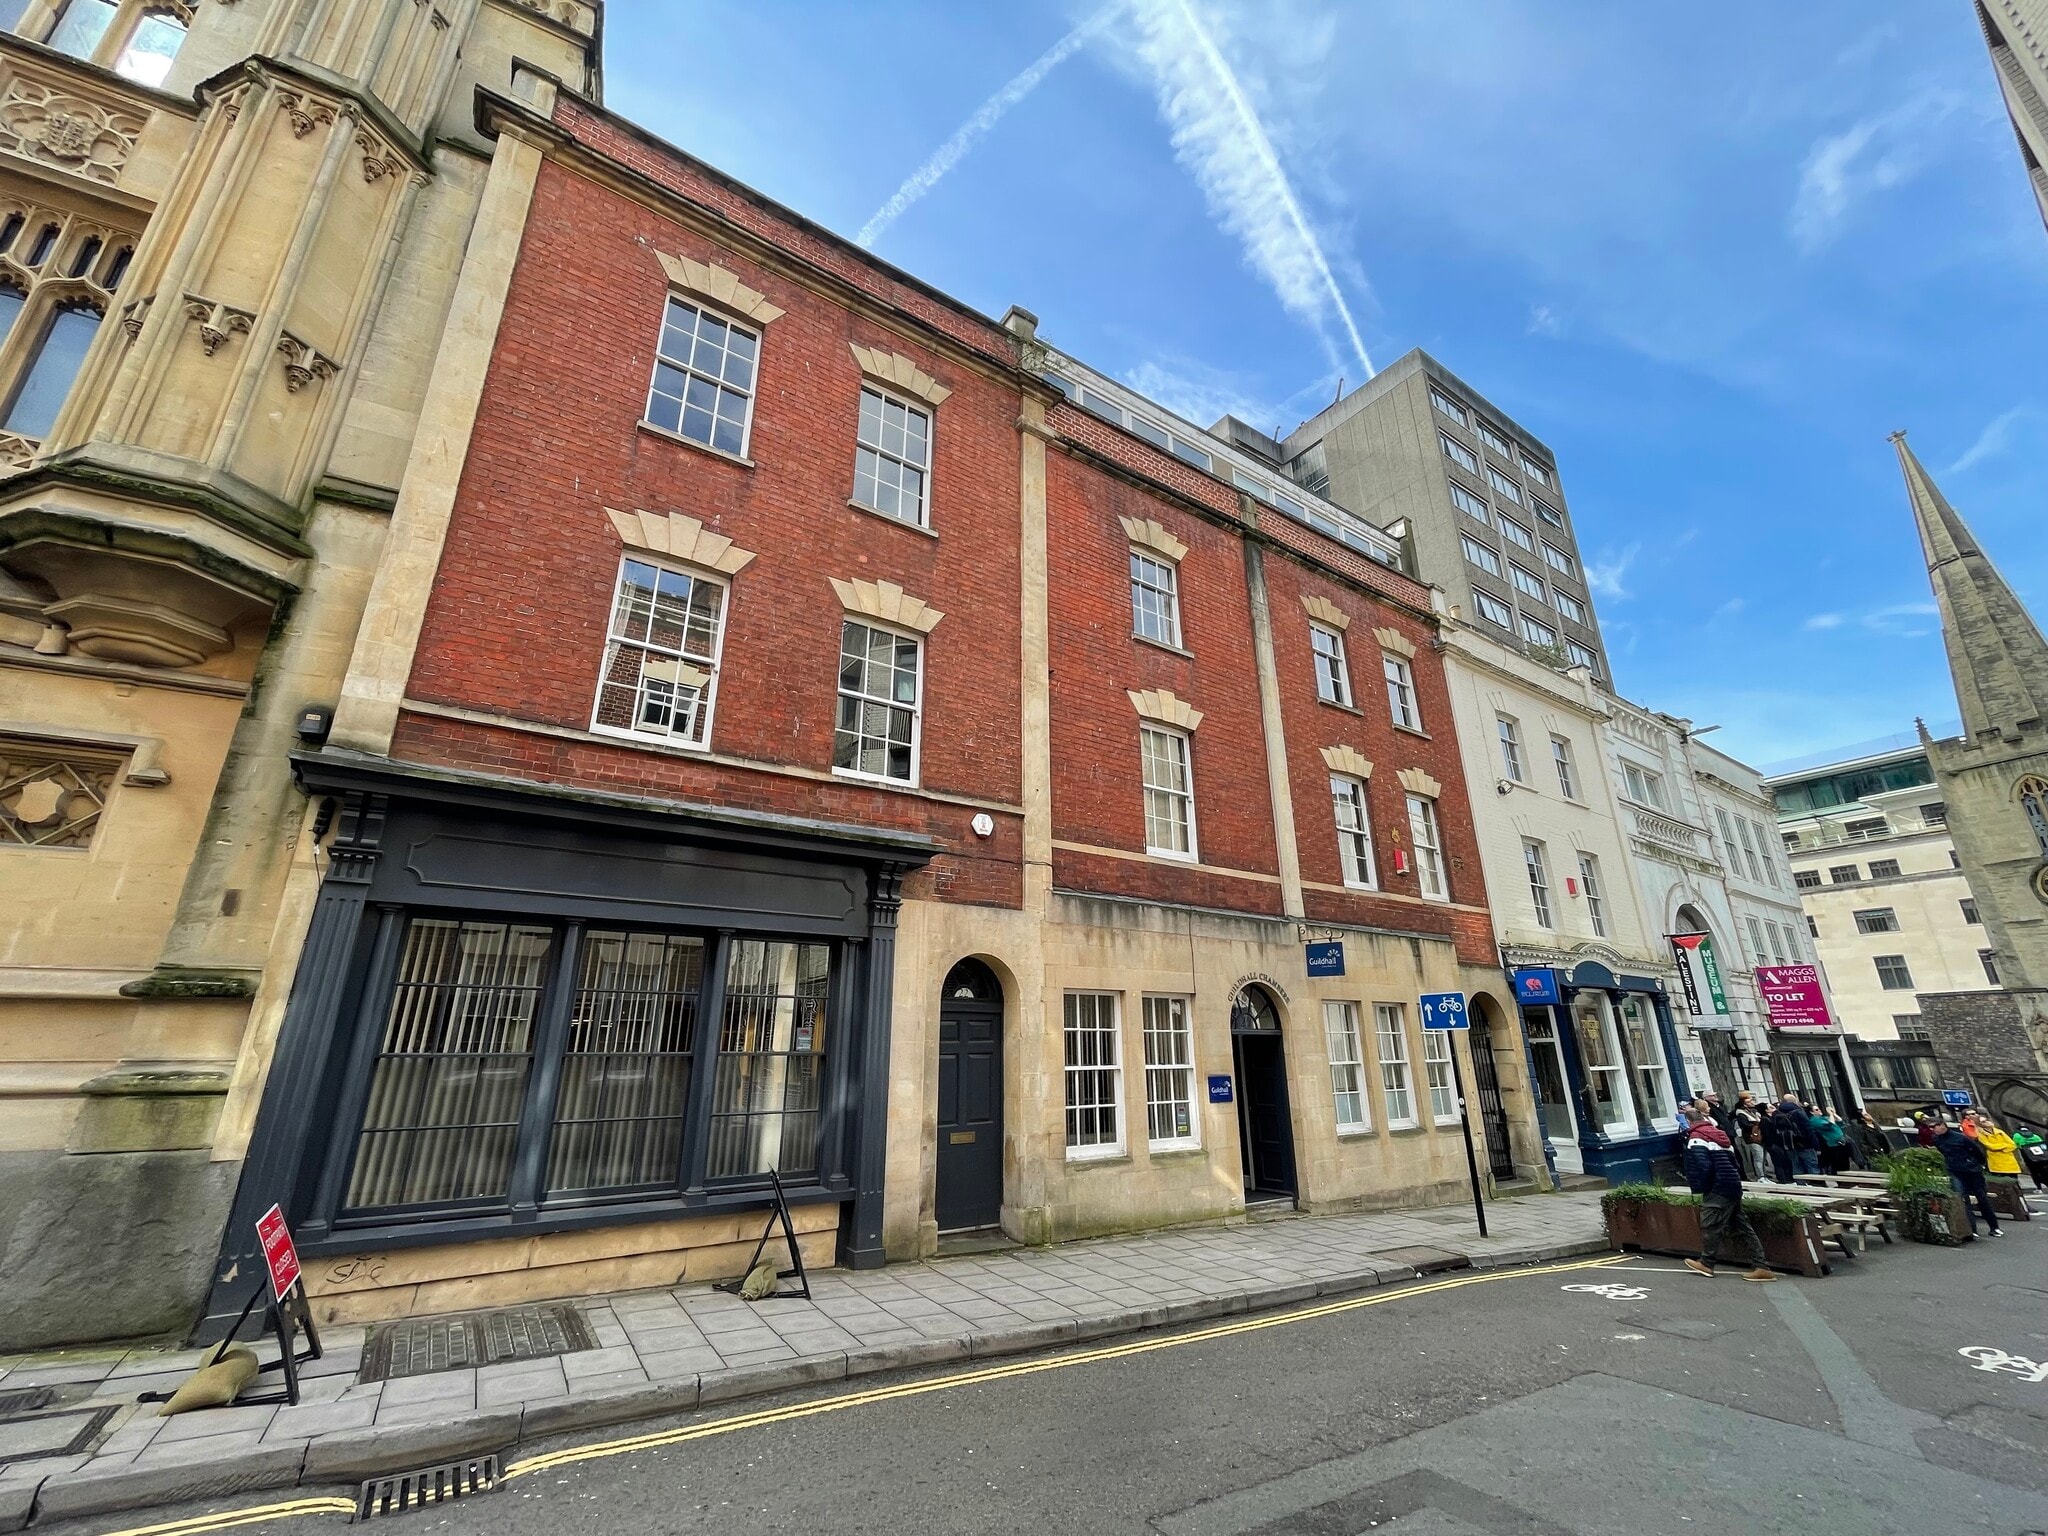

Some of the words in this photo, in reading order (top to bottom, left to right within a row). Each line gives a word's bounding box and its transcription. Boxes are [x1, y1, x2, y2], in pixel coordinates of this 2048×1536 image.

[1309, 957, 1337, 966] Guildhall
[1778, 967, 1814, 976] MAGGS
[1676, 948, 1700, 1014] PALESTINE
[1701, 949, 1722, 995] MUSEUM
[1716, 1001, 1725, 1010] &
[1788, 975, 1817, 984] ALLEN
[1227, 972, 1258, 1002] GUILDHALL
[1258, 972, 1291, 1005] CHAMBERS
[1766, 993, 1784, 1002] TO
[1785, 992, 1805, 1001] LET
